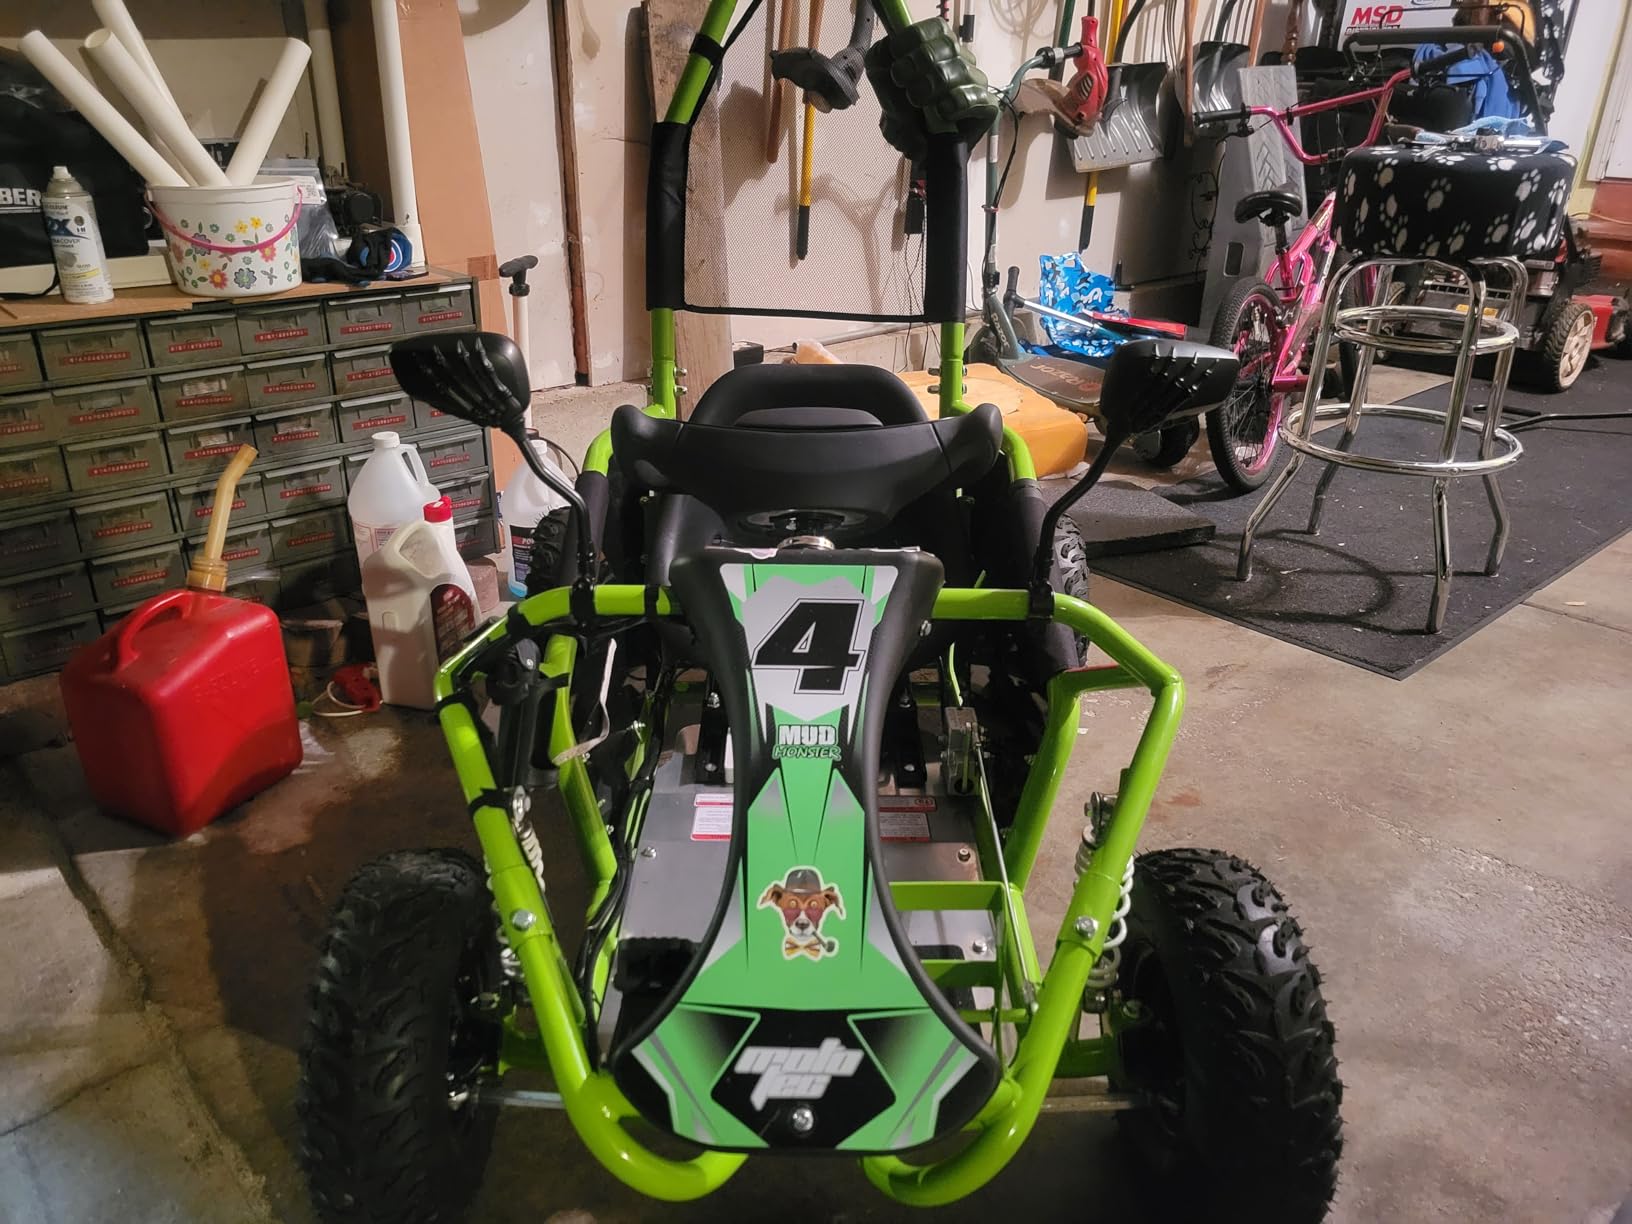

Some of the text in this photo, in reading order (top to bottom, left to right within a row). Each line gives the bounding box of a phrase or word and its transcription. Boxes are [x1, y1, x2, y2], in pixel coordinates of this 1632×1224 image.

[1350, 5, 1404, 25] MSD
[991, 312, 1010, 348] Razor
[751, 598, 866, 695] 4
[778, 724, 837, 746] MUD
[772, 744, 842, 761] MONSTER
